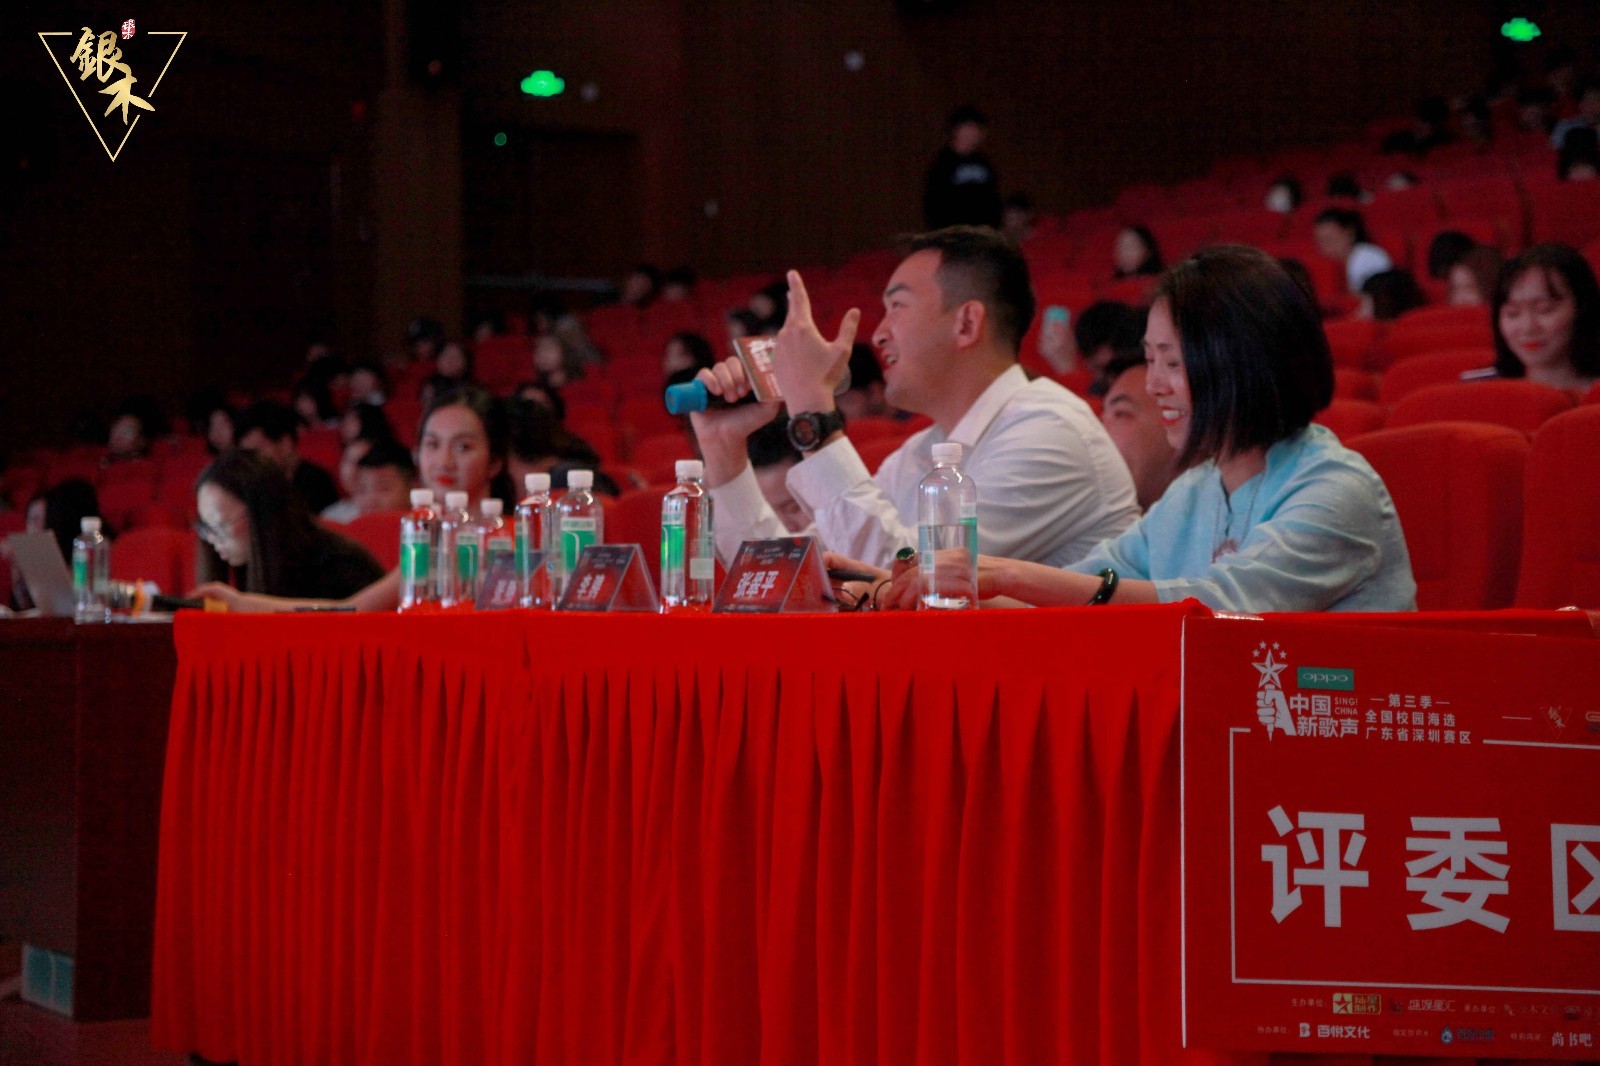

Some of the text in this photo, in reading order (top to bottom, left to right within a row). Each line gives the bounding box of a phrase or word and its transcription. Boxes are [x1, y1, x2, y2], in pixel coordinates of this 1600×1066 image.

[1289, 693, 1332, 717] 中国
[1334, 696, 1359, 707] SING!
[1388, 693, 1432, 710] 第三季
[1334, 707, 1359, 717] CHINA
[1365, 709, 1456, 728] 全国校园海选
[1296, 716, 1359, 738] 新歌声
[1365, 726, 1472, 745] 广东省深圳赛区
[1317, 1024, 1371, 1039] 百悦文化
